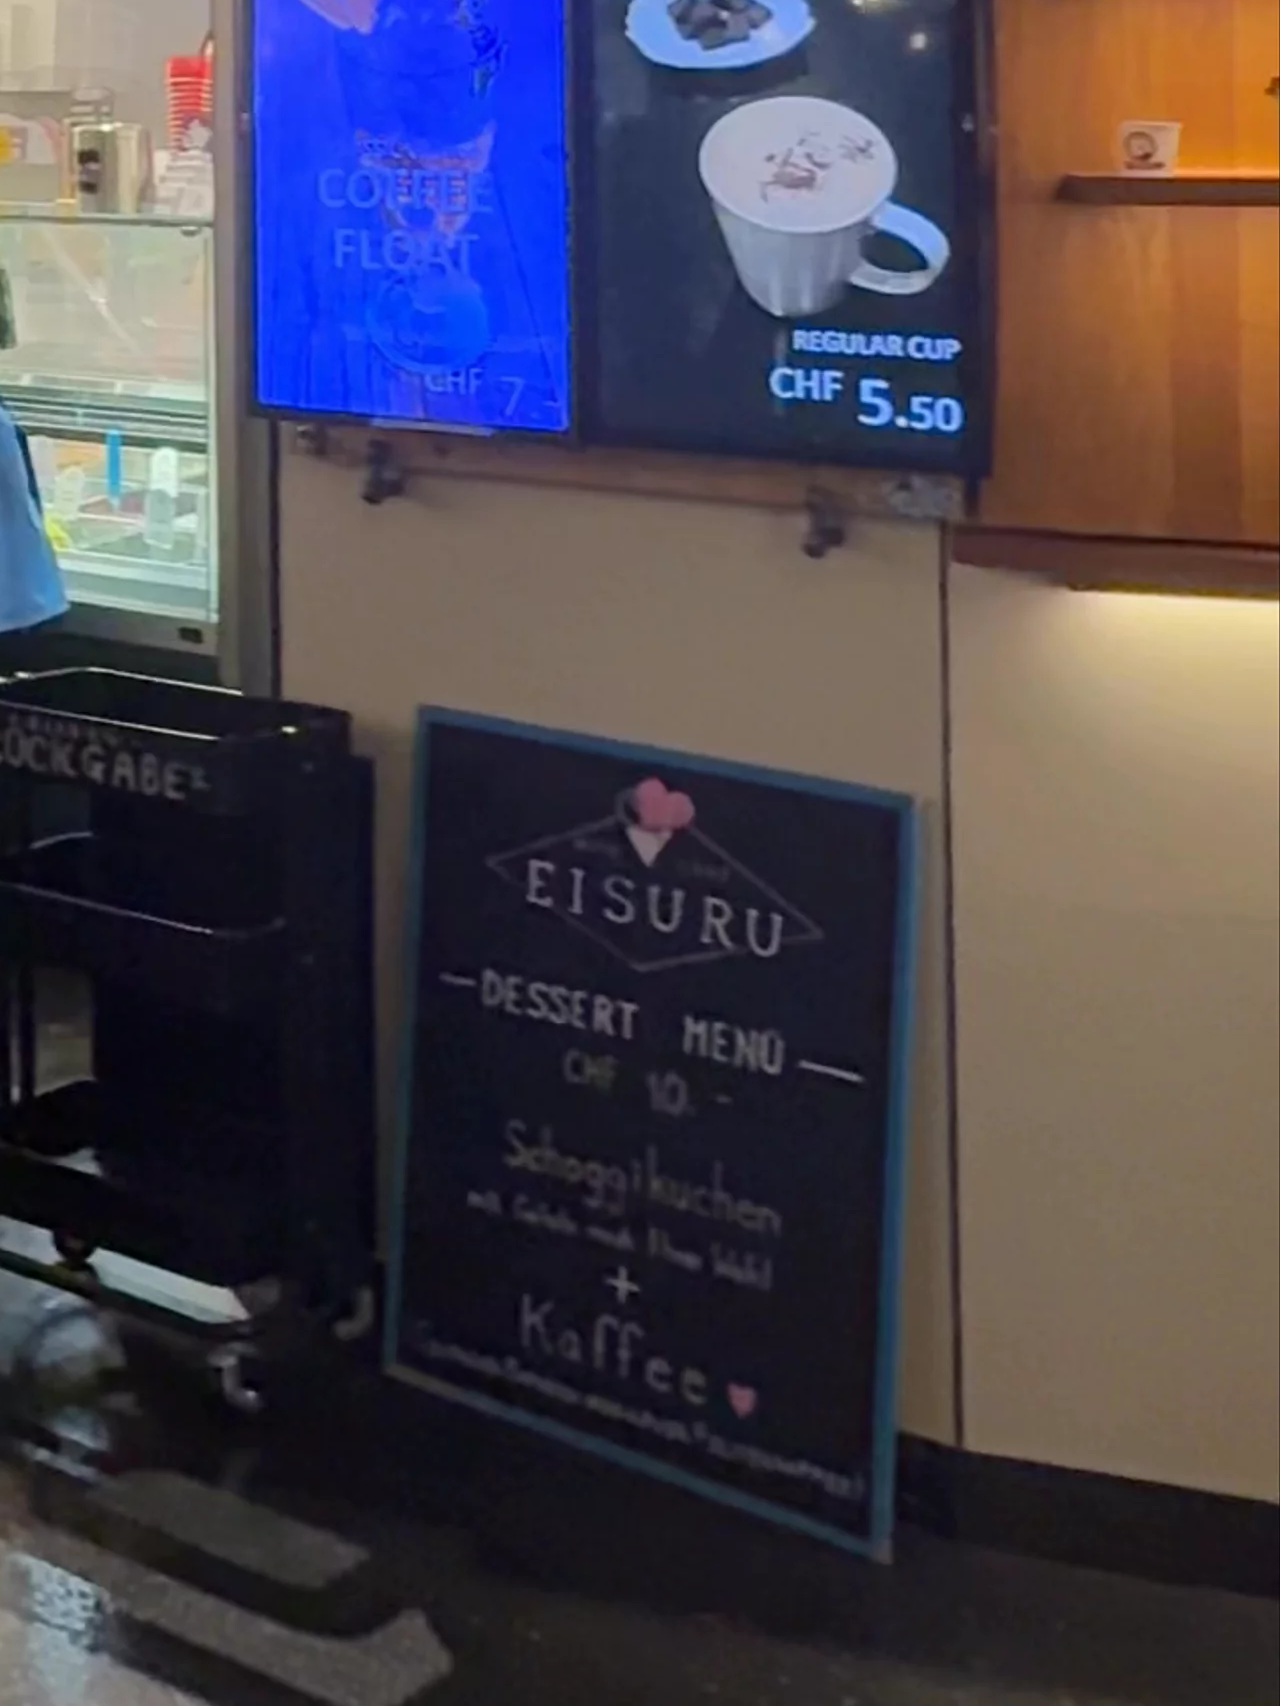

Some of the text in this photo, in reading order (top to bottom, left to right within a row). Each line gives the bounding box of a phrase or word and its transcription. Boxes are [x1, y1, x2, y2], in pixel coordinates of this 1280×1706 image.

[318, 167, 494, 214] COFFEE
[334, 227, 481, 273] FLOAT
[793, 329, 963, 360] REGULAR CUP
[769, 366, 964, 432] CHF 5.50
[525, 858, 784, 958] EISURU
[480, 967, 640, 1040] DESSERT
[519, 1292, 709, 1406] Kaffee
